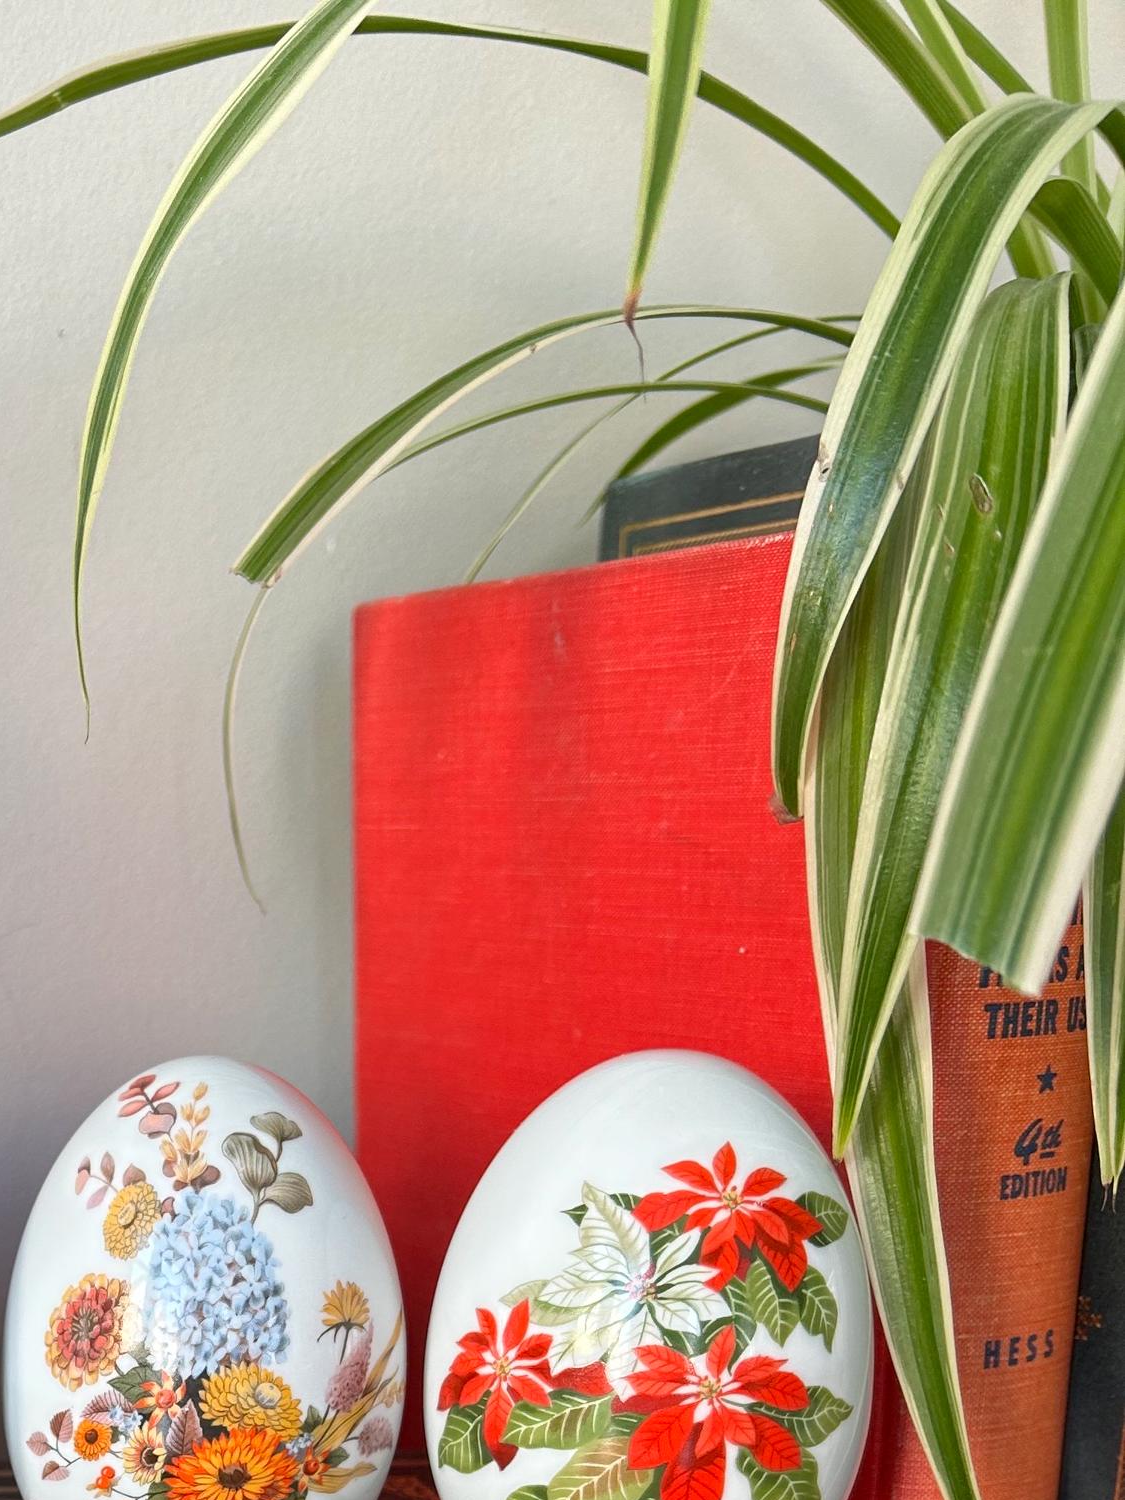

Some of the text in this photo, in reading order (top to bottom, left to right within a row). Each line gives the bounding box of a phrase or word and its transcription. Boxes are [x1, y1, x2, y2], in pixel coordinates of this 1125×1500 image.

[984, 994, 1087, 1040] THEIR US
[999, 1166, 1068, 1200] EDITION
[983, 1329, 1056, 1369] HESS
